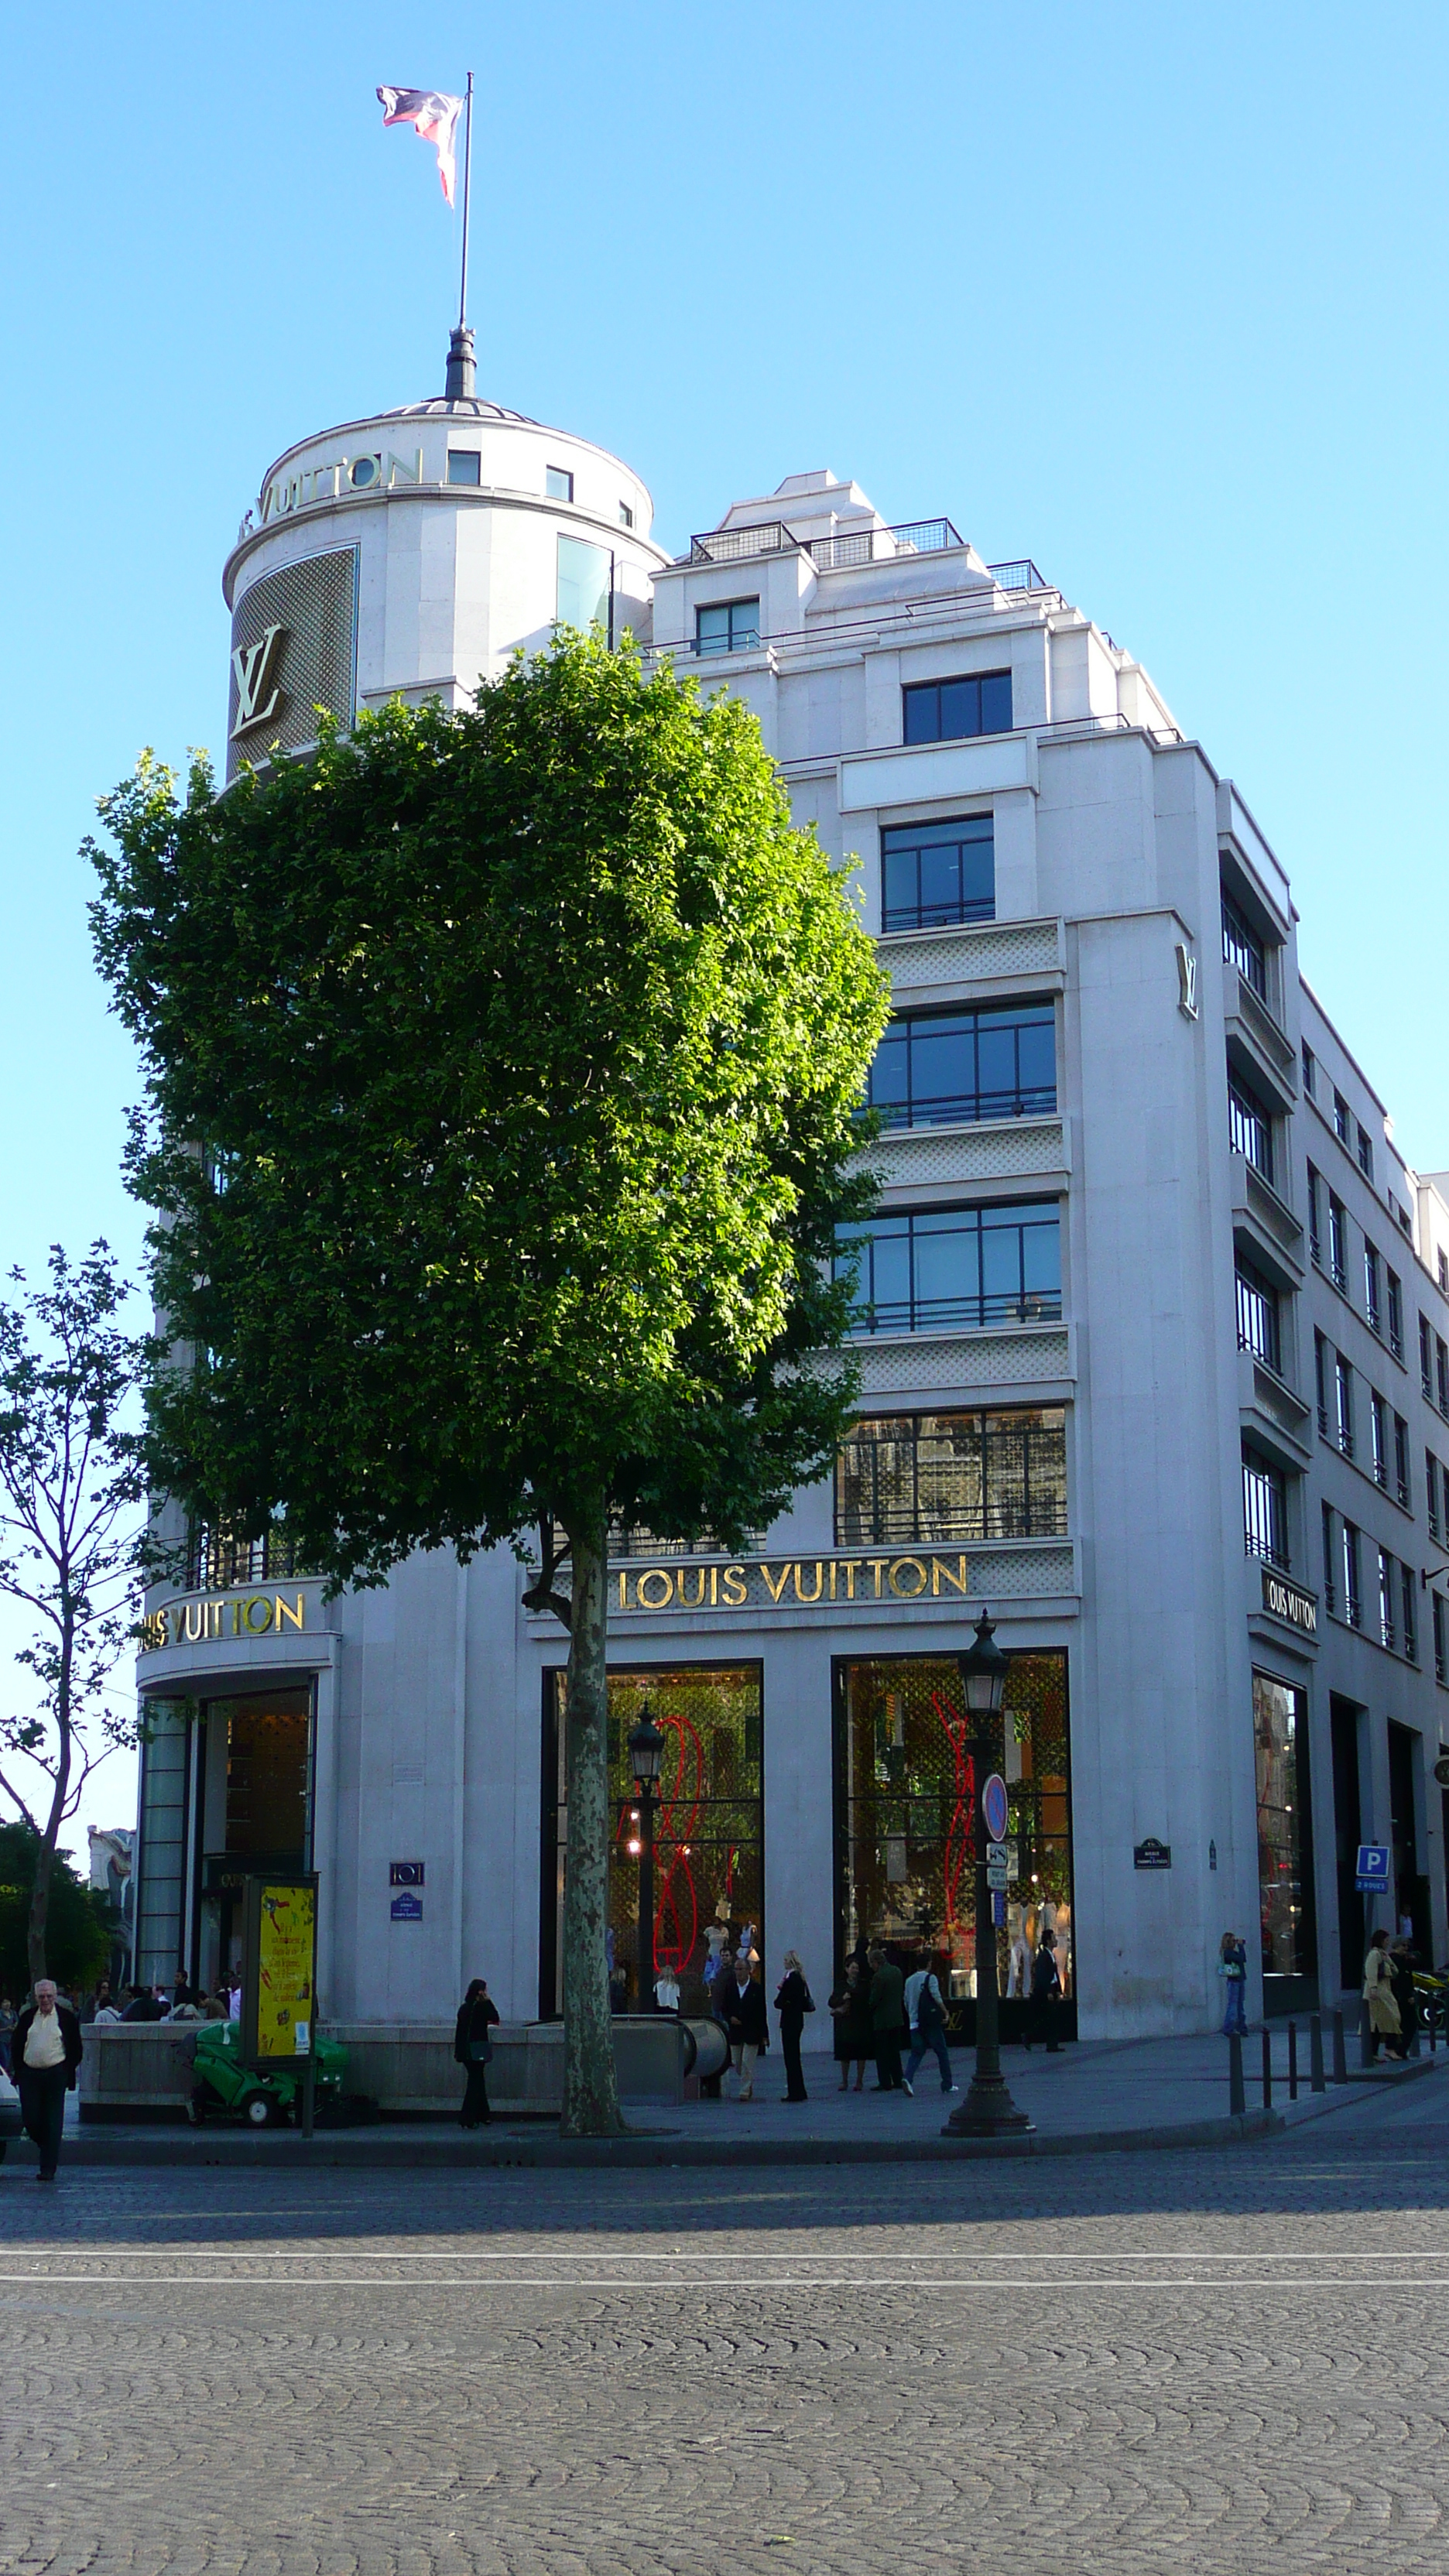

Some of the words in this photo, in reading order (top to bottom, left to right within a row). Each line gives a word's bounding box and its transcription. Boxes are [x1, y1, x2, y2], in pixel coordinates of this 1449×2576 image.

[255, 447, 423, 523] VUITTON
[619, 1564, 748, 1610] LOUIS
[759, 1555, 967, 1605] VUITTON
[170, 1594, 304, 1643] VUITTON
[393, 1864, 421, 1883] 101
[1367, 1852, 1381, 1870] P
[1363, 1881, 1386, 1890] ROUES
